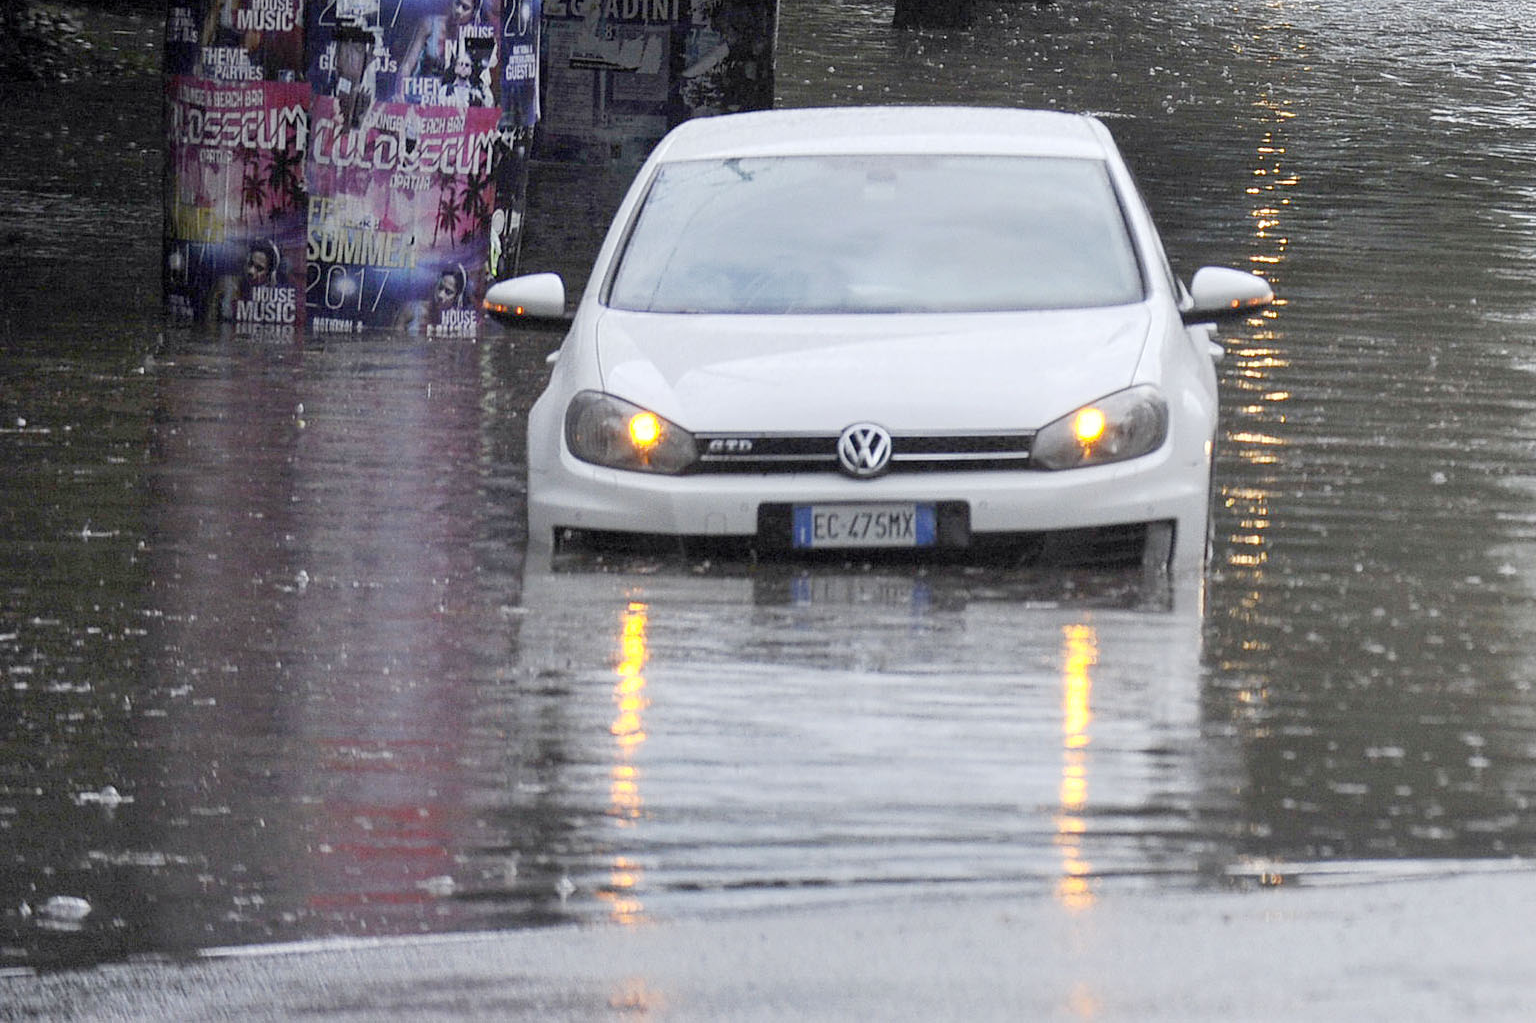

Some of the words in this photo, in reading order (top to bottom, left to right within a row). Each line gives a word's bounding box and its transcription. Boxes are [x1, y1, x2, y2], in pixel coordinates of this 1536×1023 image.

[237, 9, 294, 31] MUSIC
[201, 46, 250, 66] THEME
[214, 65, 264, 81] PARTIES
[214, 91, 243, 107] BEACH
[307, 230, 418, 268] SUMMER
[252, 286, 296, 303] HOUSE
[305, 262, 390, 313] 2017
[236, 300, 296, 323] MUSIC
[441, 310, 477, 325] HOUSE
[709, 439, 753, 452] GTD
[841, 426, 889, 470] VW
